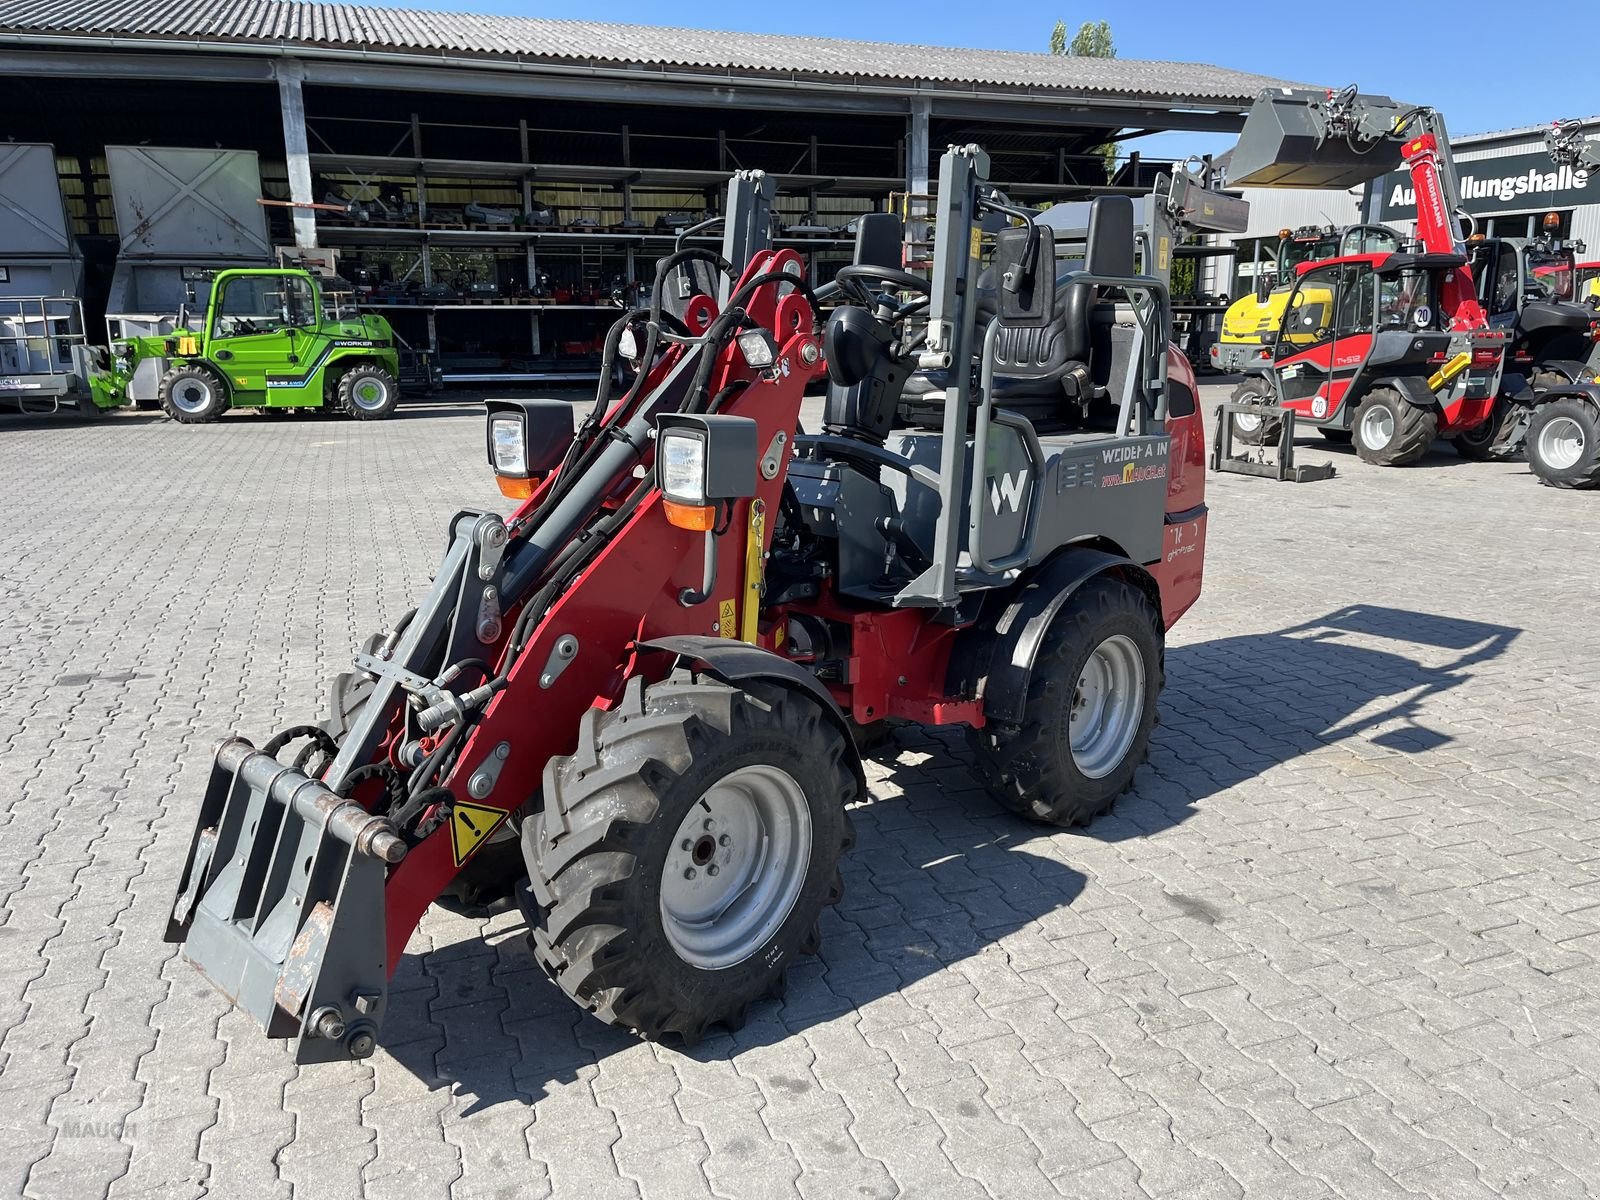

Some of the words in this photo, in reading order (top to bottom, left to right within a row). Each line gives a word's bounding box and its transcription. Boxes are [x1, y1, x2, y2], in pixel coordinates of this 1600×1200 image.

[1388, 165, 1589, 208] Aullungshalle
[1424, 166, 1444, 229] WEIDEMANN
[1417, 308, 1428, 323] 20
[1314, 400, 1325, 414] 20
